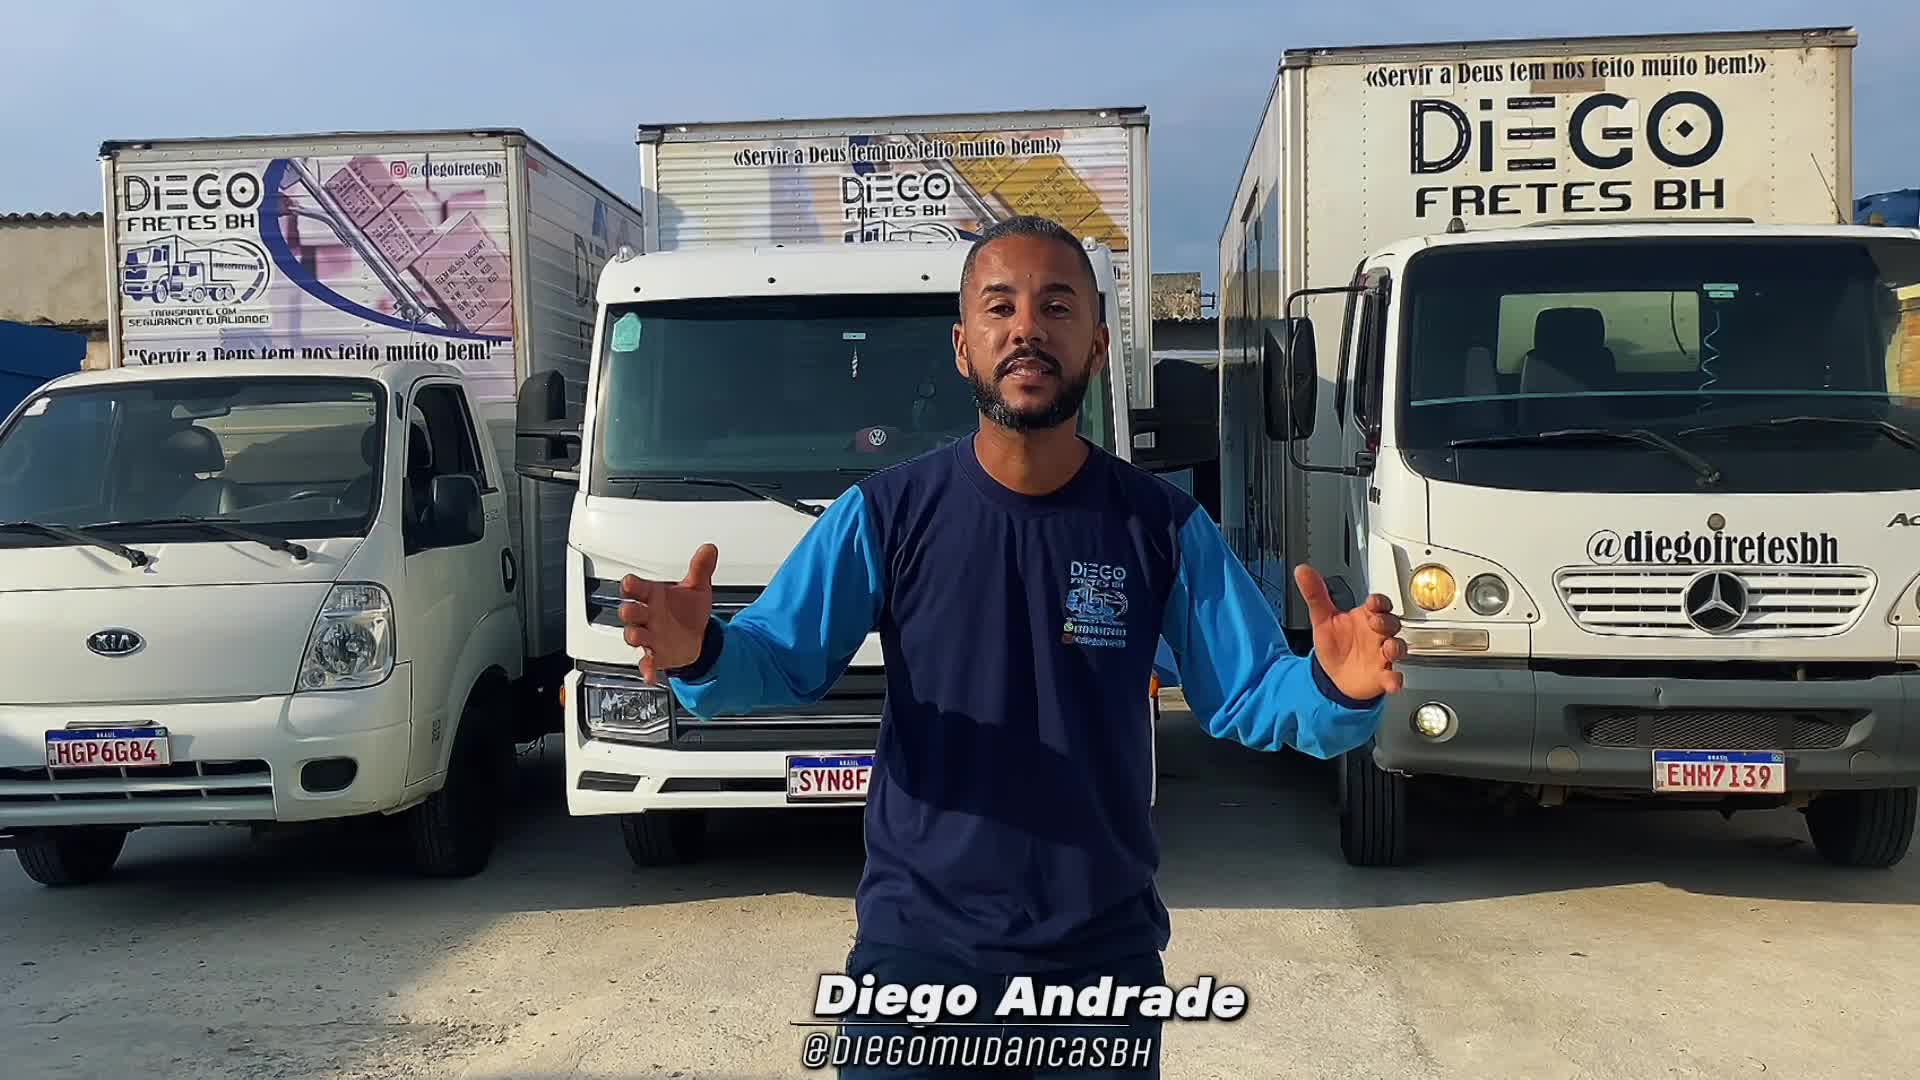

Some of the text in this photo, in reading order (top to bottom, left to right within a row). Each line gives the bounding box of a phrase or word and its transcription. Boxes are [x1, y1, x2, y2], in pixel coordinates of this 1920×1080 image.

[1366, 54, 1767, 88] «Servir a Deus tem nos feito muito bem!»
[734, 137, 1061, 166] «Servir a Deus tem nos feito muito bem!»
[1416, 179, 1725, 217] FRETES BH
[127, 213, 255, 232] FRETES BH
[845, 204, 946, 219] FRETES BH
[196, 350, 206, 361] a
[261, 345, 295, 360] tem
[301, 345, 332, 360] nos
[338, 343, 380, 361] feito
[386, 342, 439, 361] muito
[1586, 529, 1839, 566] @diegofretesbh
[95, 634, 132, 650] KIA
[56, 740, 157, 765] HGP6G84
